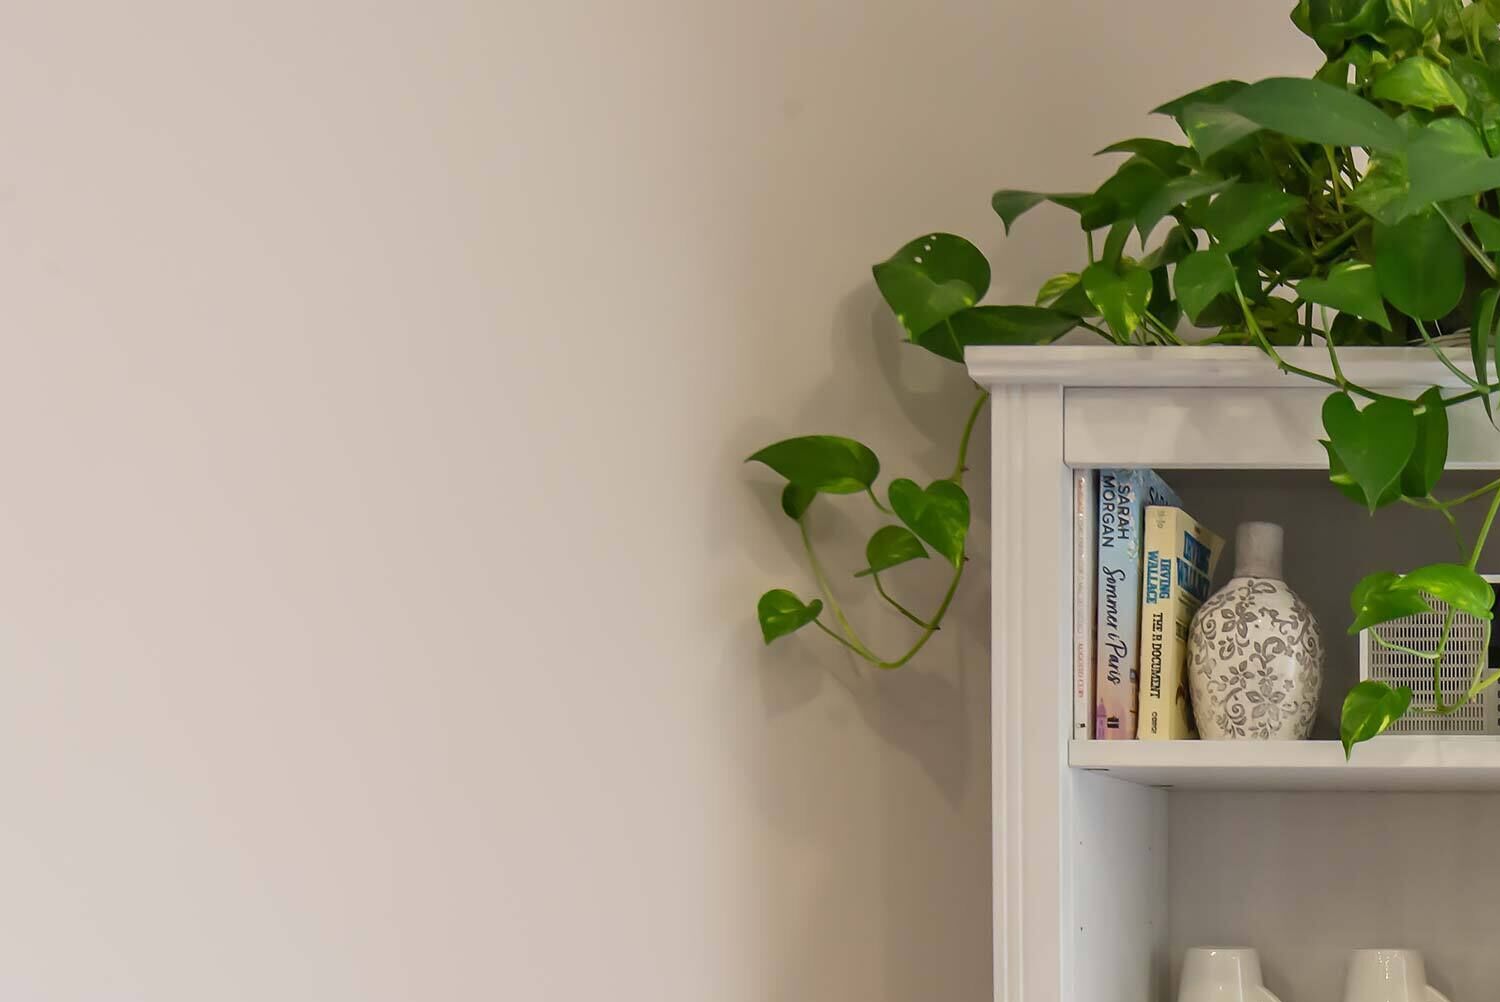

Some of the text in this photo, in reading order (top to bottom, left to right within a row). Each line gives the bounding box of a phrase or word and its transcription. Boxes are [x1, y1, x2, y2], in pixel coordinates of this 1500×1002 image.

[1102, 475, 1115, 548] MORGAN
[1117, 485, 1130, 540] SARAH
[1102, 566, 1126, 632] Sommer
[1146, 550, 1159, 605] WALLACE
[1159, 558, 1171, 599] IRVING
[1152, 612, 1164, 632] THE
[1104, 640, 1128, 685] Paris
[1150, 643, 1162, 699] DOCUMENT
